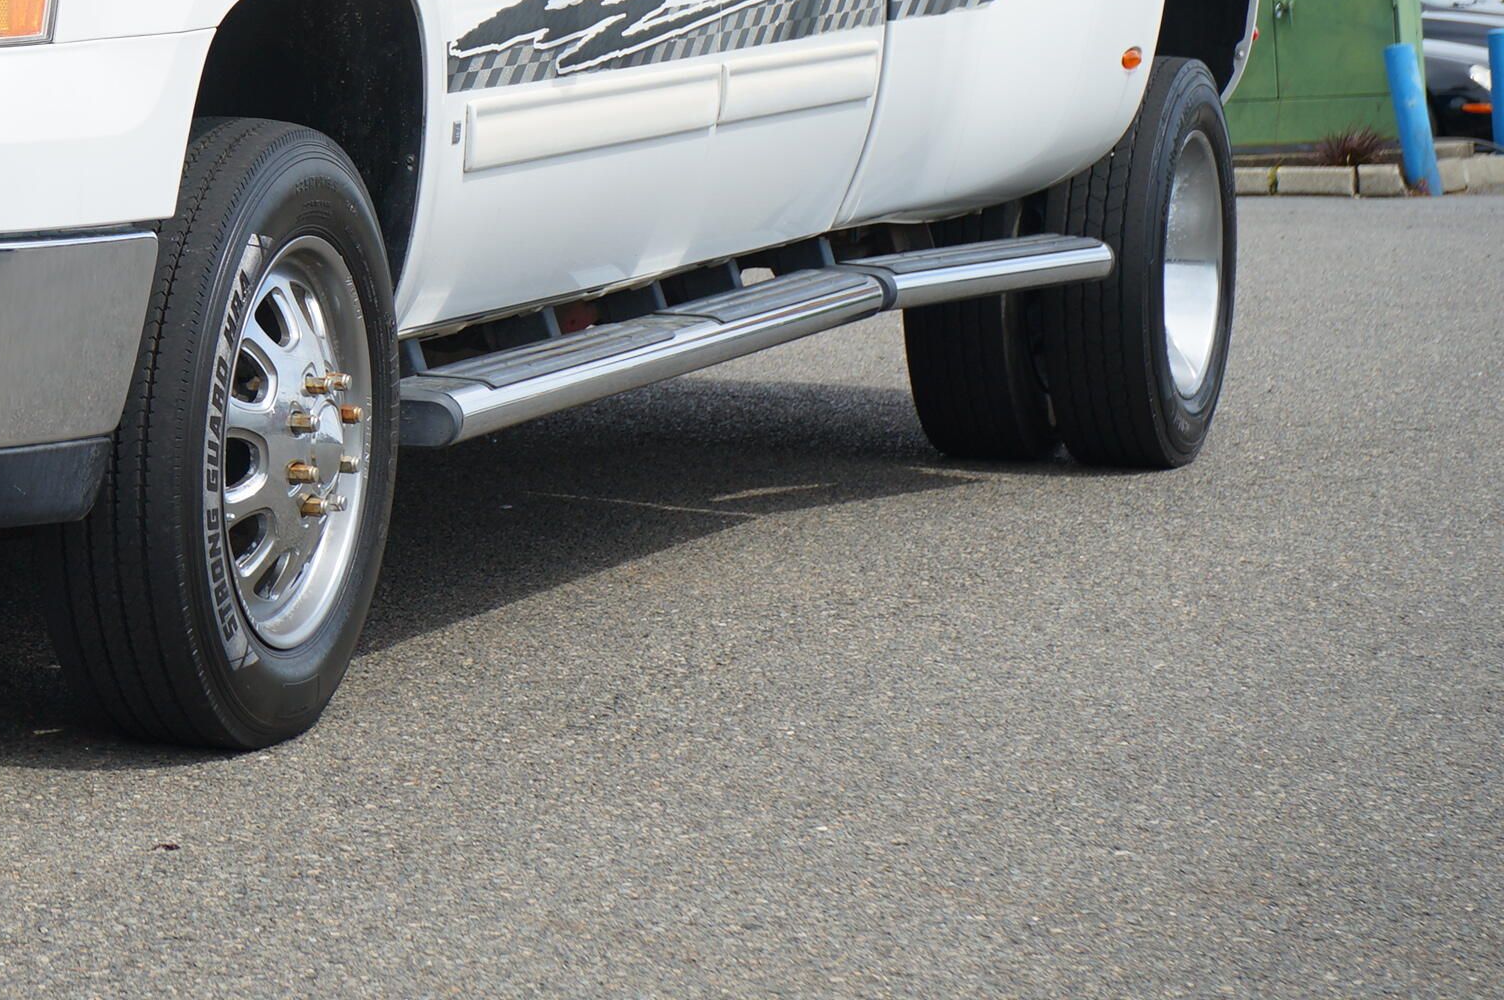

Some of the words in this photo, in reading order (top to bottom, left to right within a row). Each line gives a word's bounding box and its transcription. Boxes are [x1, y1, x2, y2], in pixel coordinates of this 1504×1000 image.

[224, 269, 251, 351] HRA
[206, 356, 229, 493] GUARD
[207, 507, 238, 642] STRONG
